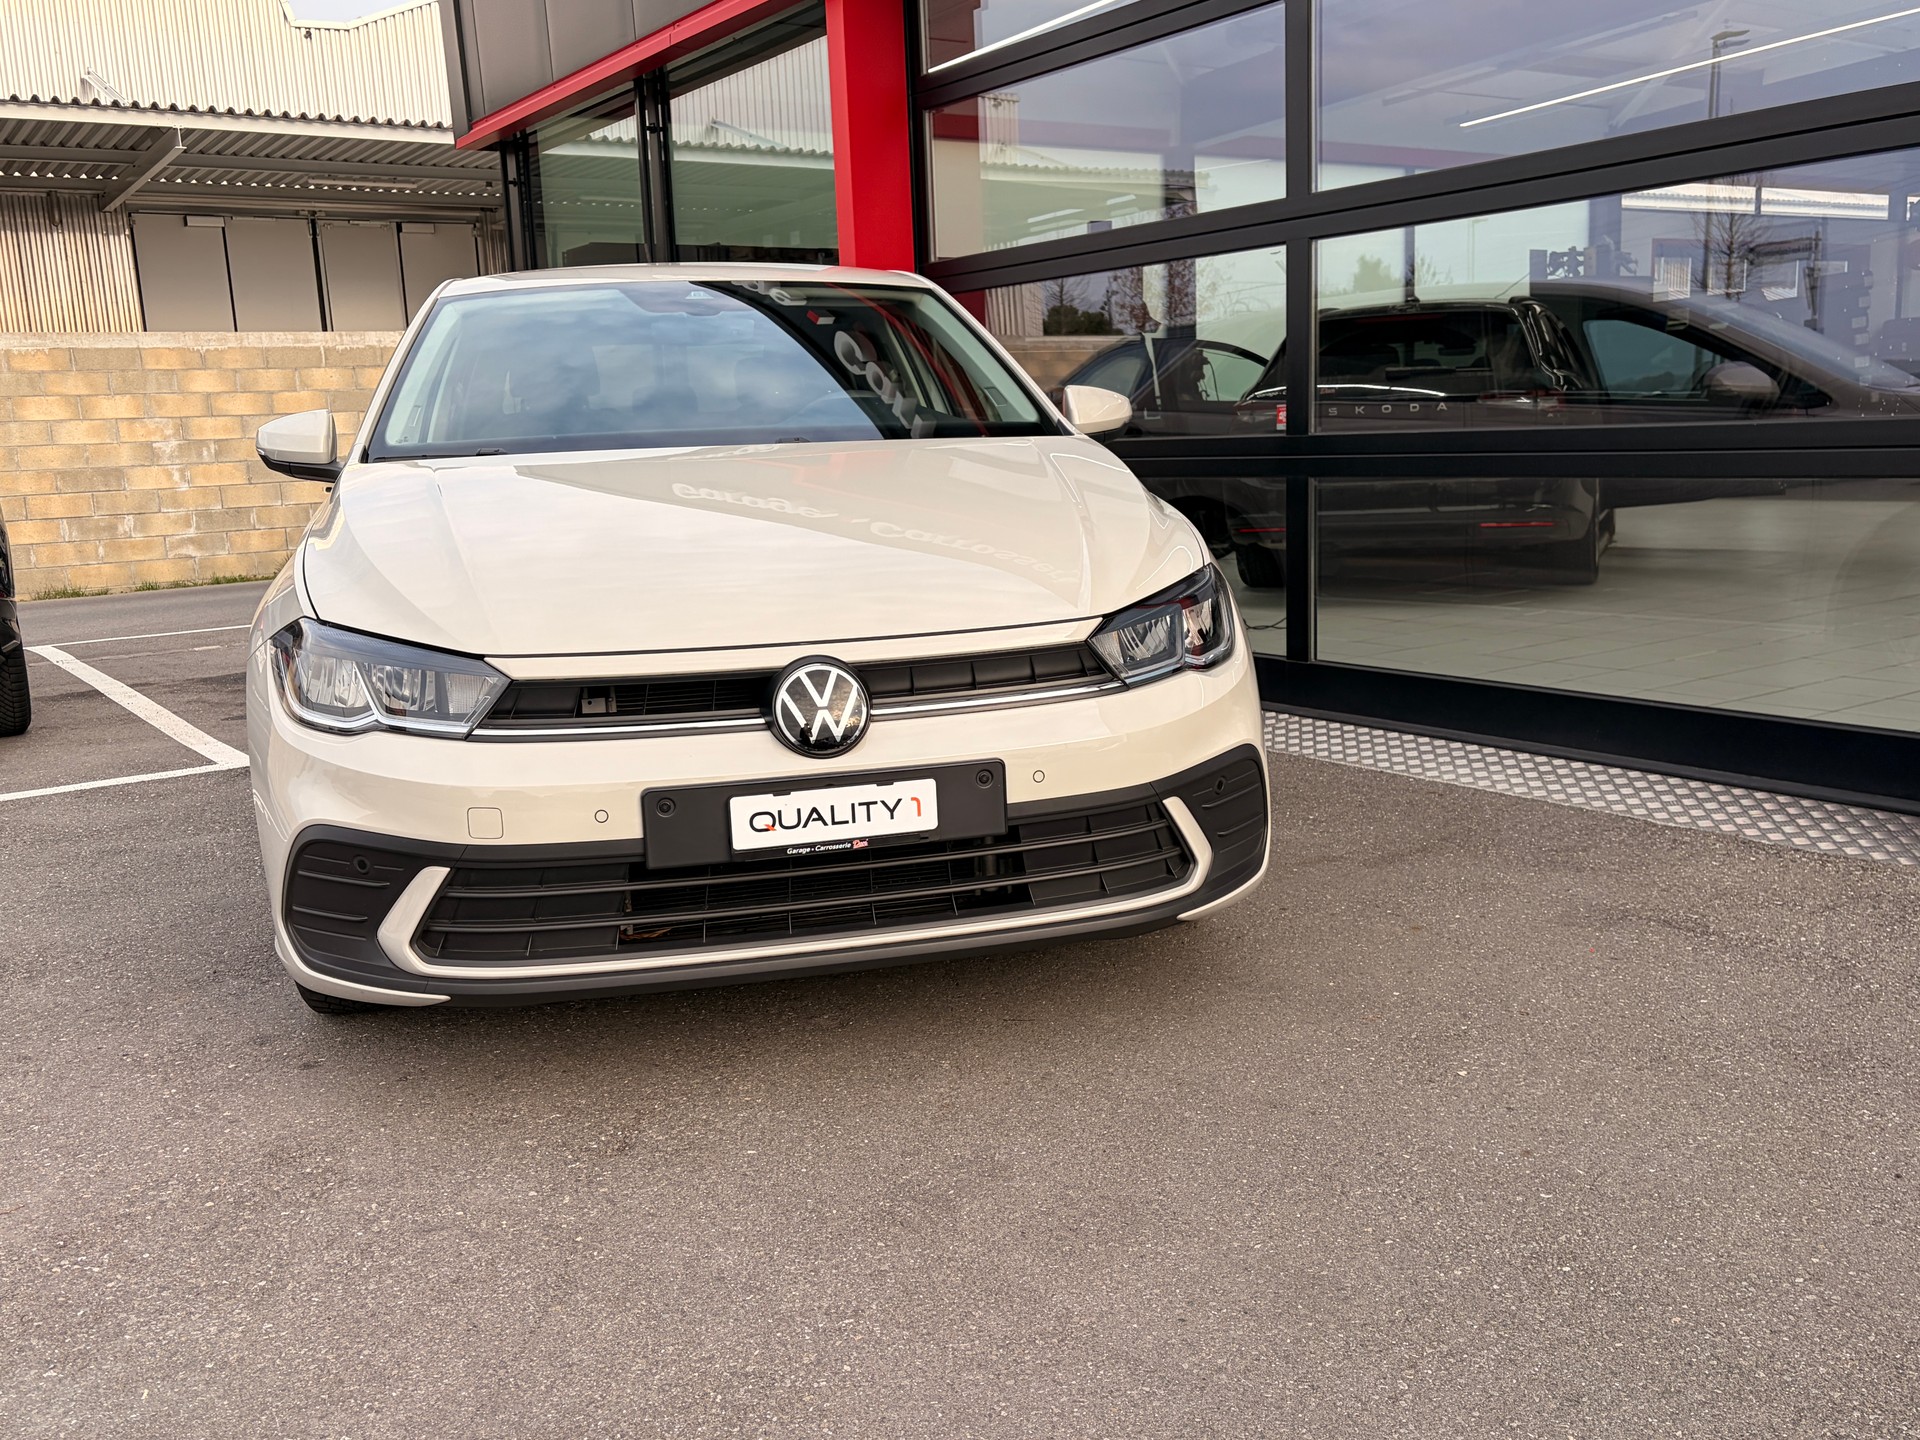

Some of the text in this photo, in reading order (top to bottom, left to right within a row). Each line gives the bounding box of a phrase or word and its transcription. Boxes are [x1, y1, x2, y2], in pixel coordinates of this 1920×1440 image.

[749, 796, 922, 833] QUALITY 1
[786, 847, 811, 855] Garage
[815, 842, 852, 852] Carrosserie
